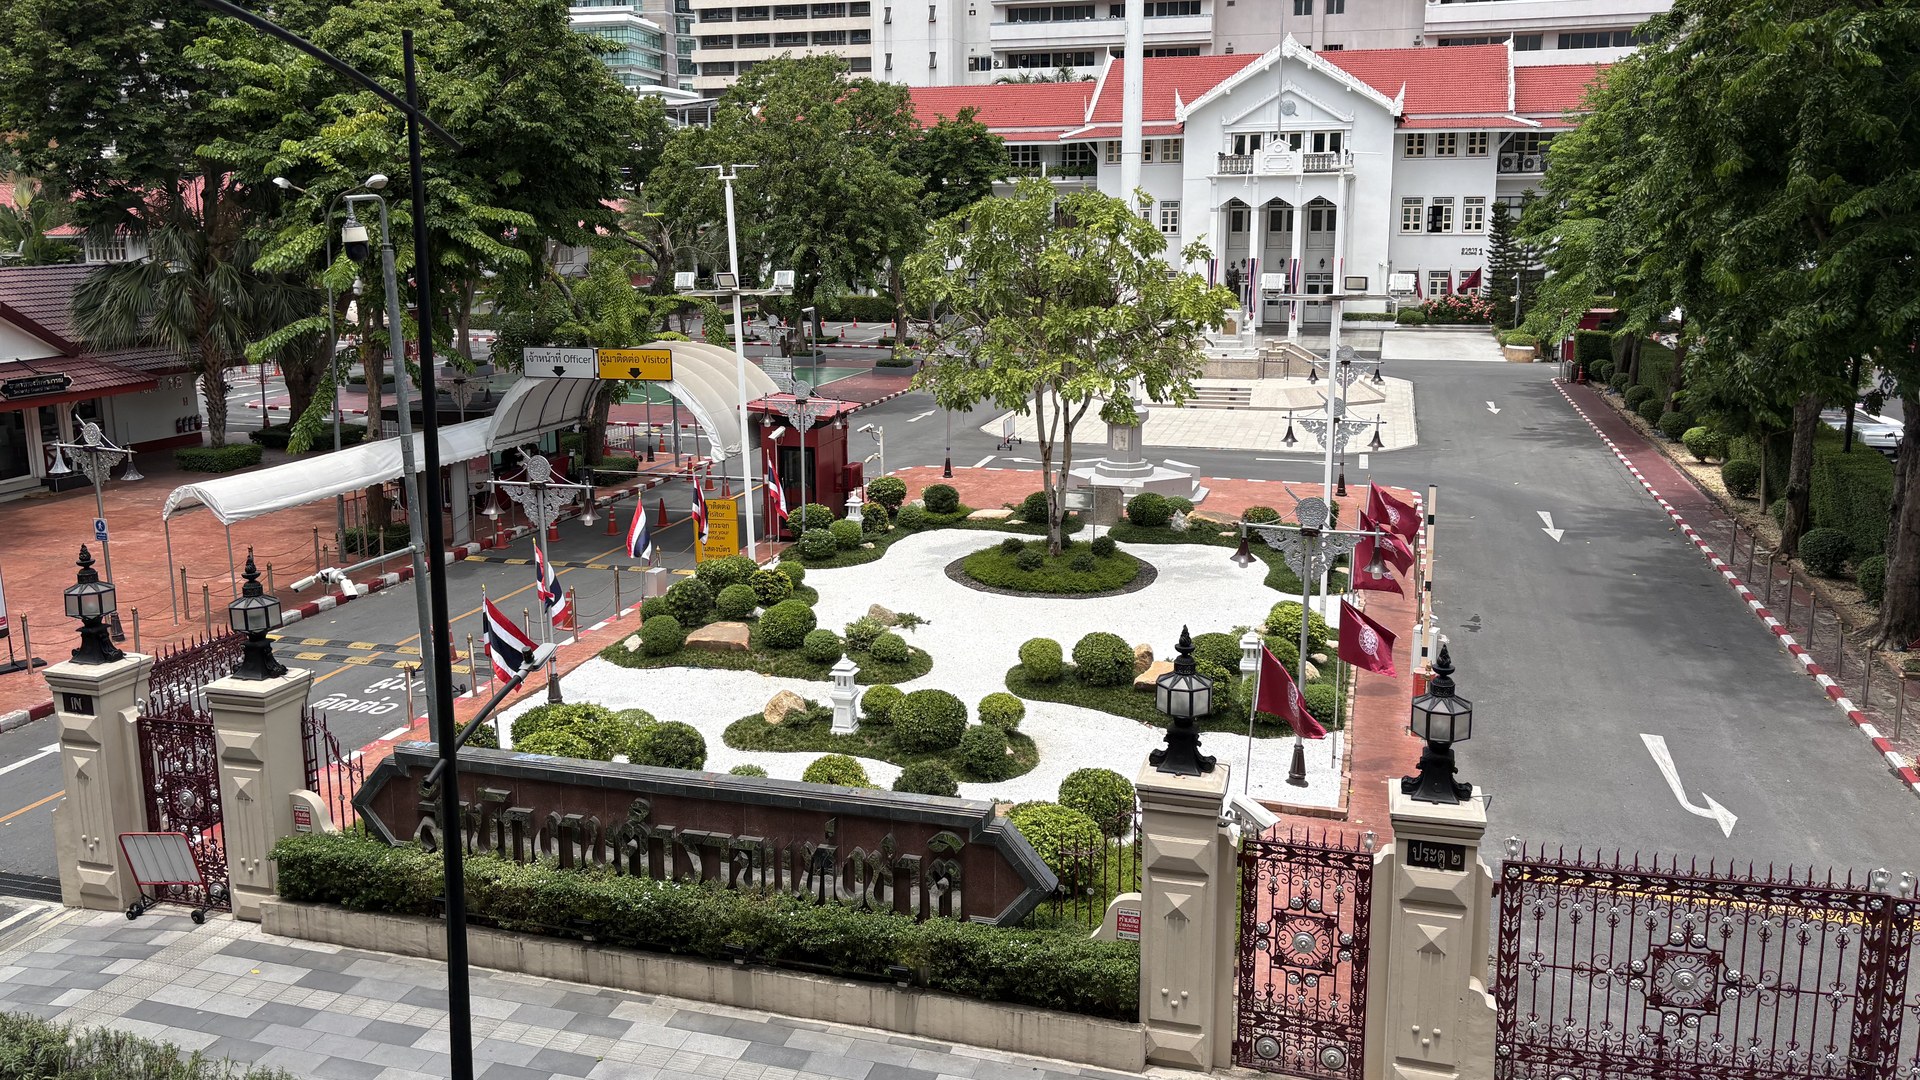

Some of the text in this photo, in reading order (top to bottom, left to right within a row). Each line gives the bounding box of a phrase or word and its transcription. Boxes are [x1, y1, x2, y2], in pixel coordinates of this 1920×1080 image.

[526, 350, 591, 364] เจ้าหน้าที่ Officer
[600, 352, 669, 366] ผู้มาติดต่อ Visitor
[70, 697, 82, 710] IN
[309, 693, 399, 714] ติดต่อ
[1412, 842, 1460, 869] ประตู ๒
